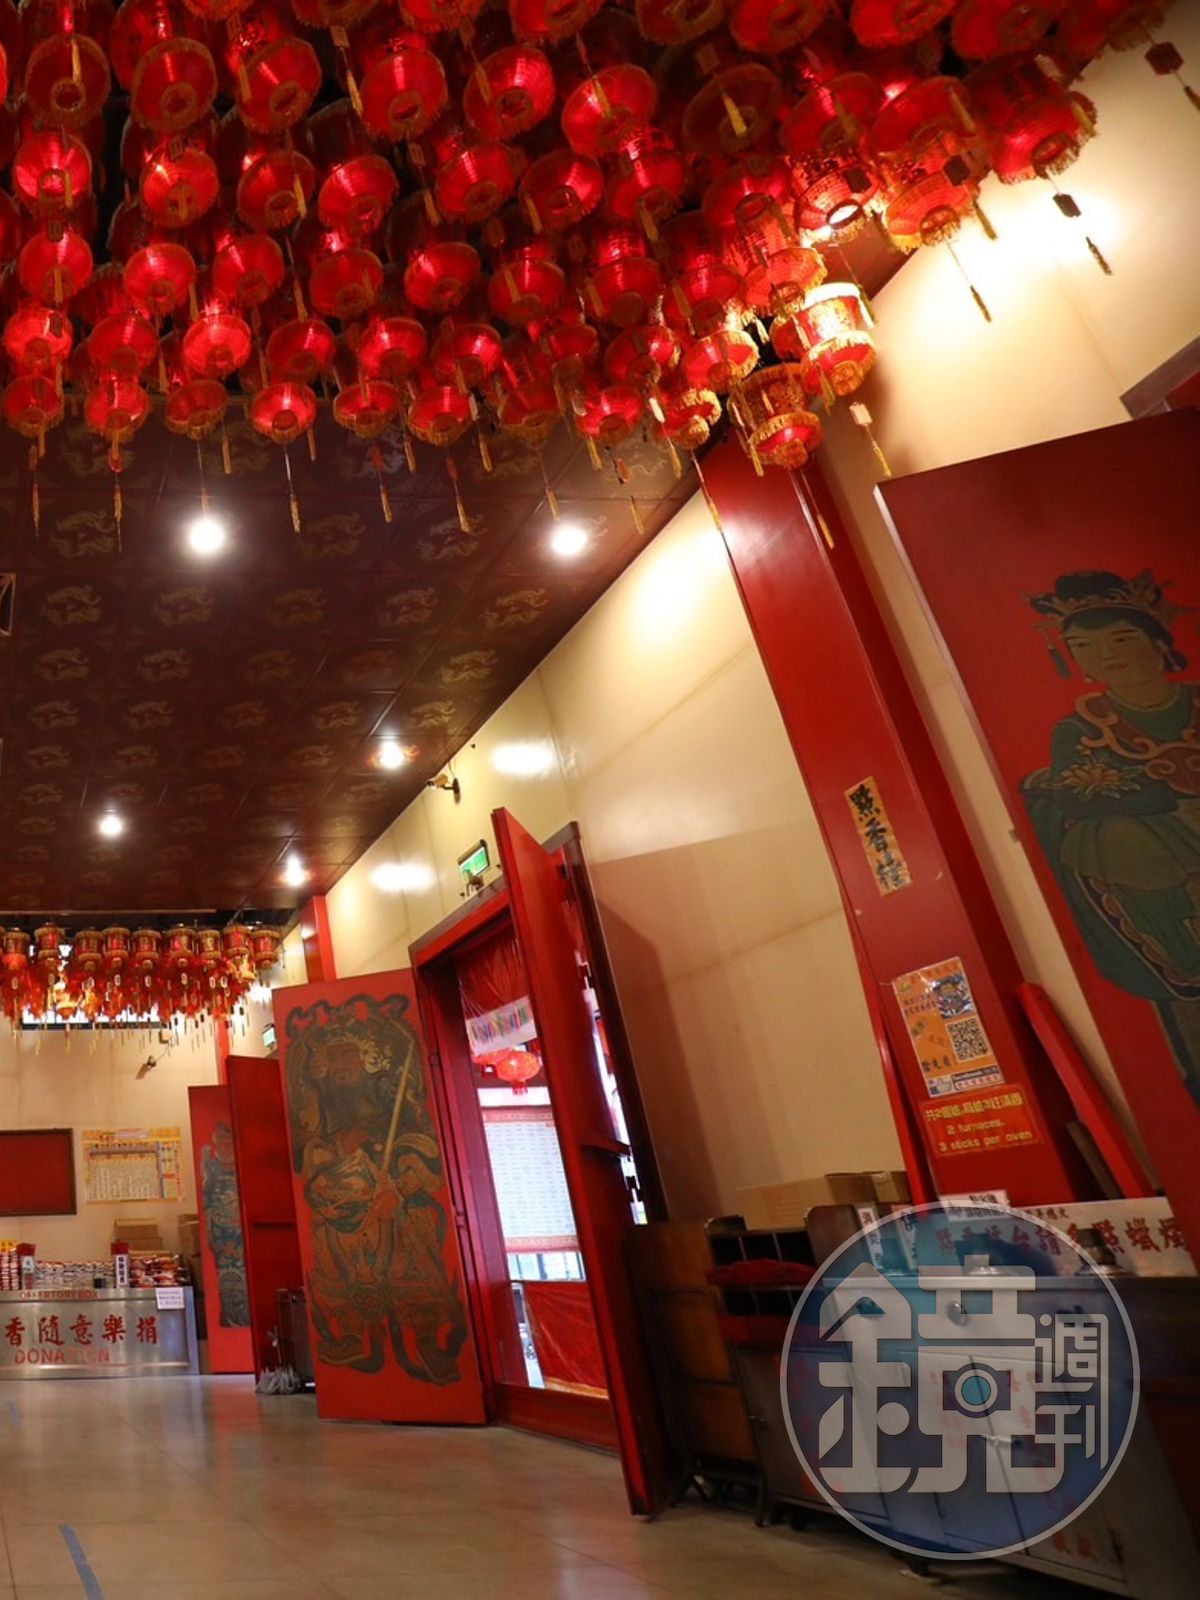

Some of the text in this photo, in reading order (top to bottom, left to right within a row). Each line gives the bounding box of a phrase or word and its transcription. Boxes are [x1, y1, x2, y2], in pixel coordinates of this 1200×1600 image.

[946, 1125, 955, 1135] 2
[938, 1131, 1032, 1152] 3 sticks per oven
